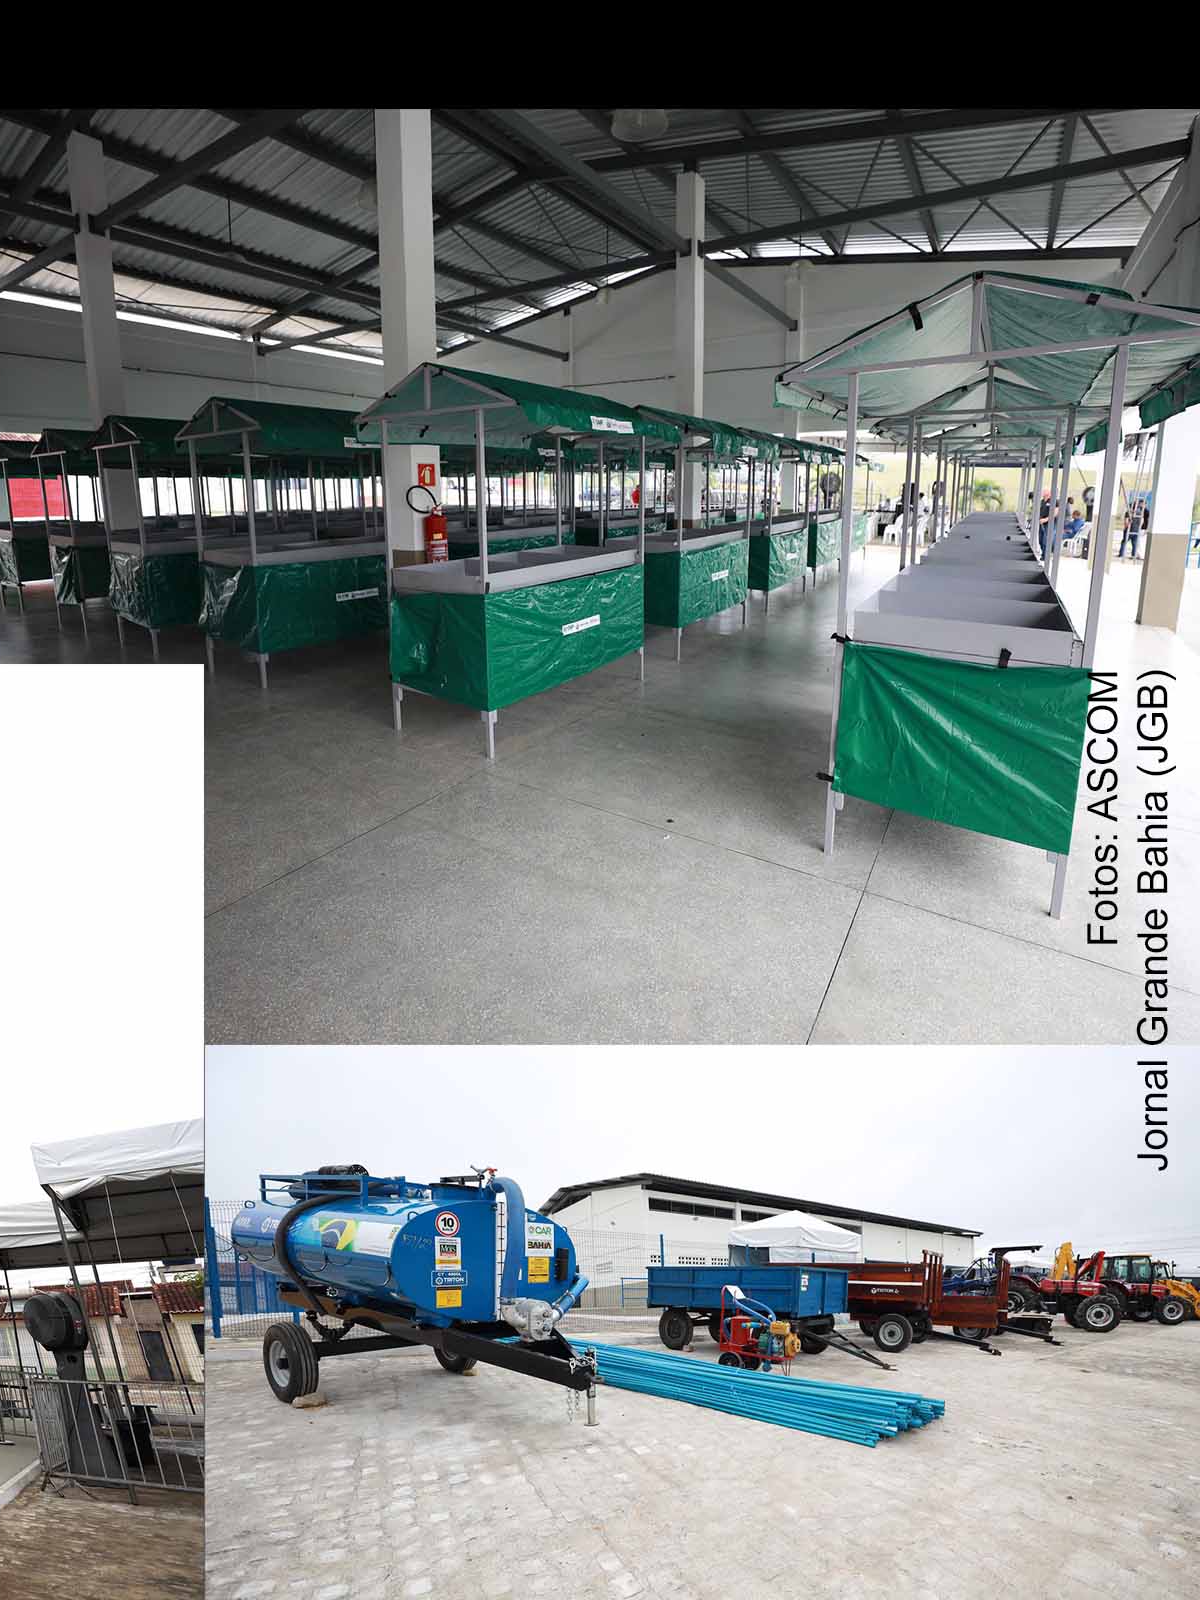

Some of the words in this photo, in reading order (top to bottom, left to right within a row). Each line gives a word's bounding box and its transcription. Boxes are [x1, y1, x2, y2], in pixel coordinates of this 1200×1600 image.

[441, 1217, 455, 1228] 10
[535, 1226, 552, 1235] CAR
[528, 1241, 552, 1250] BAHIA
